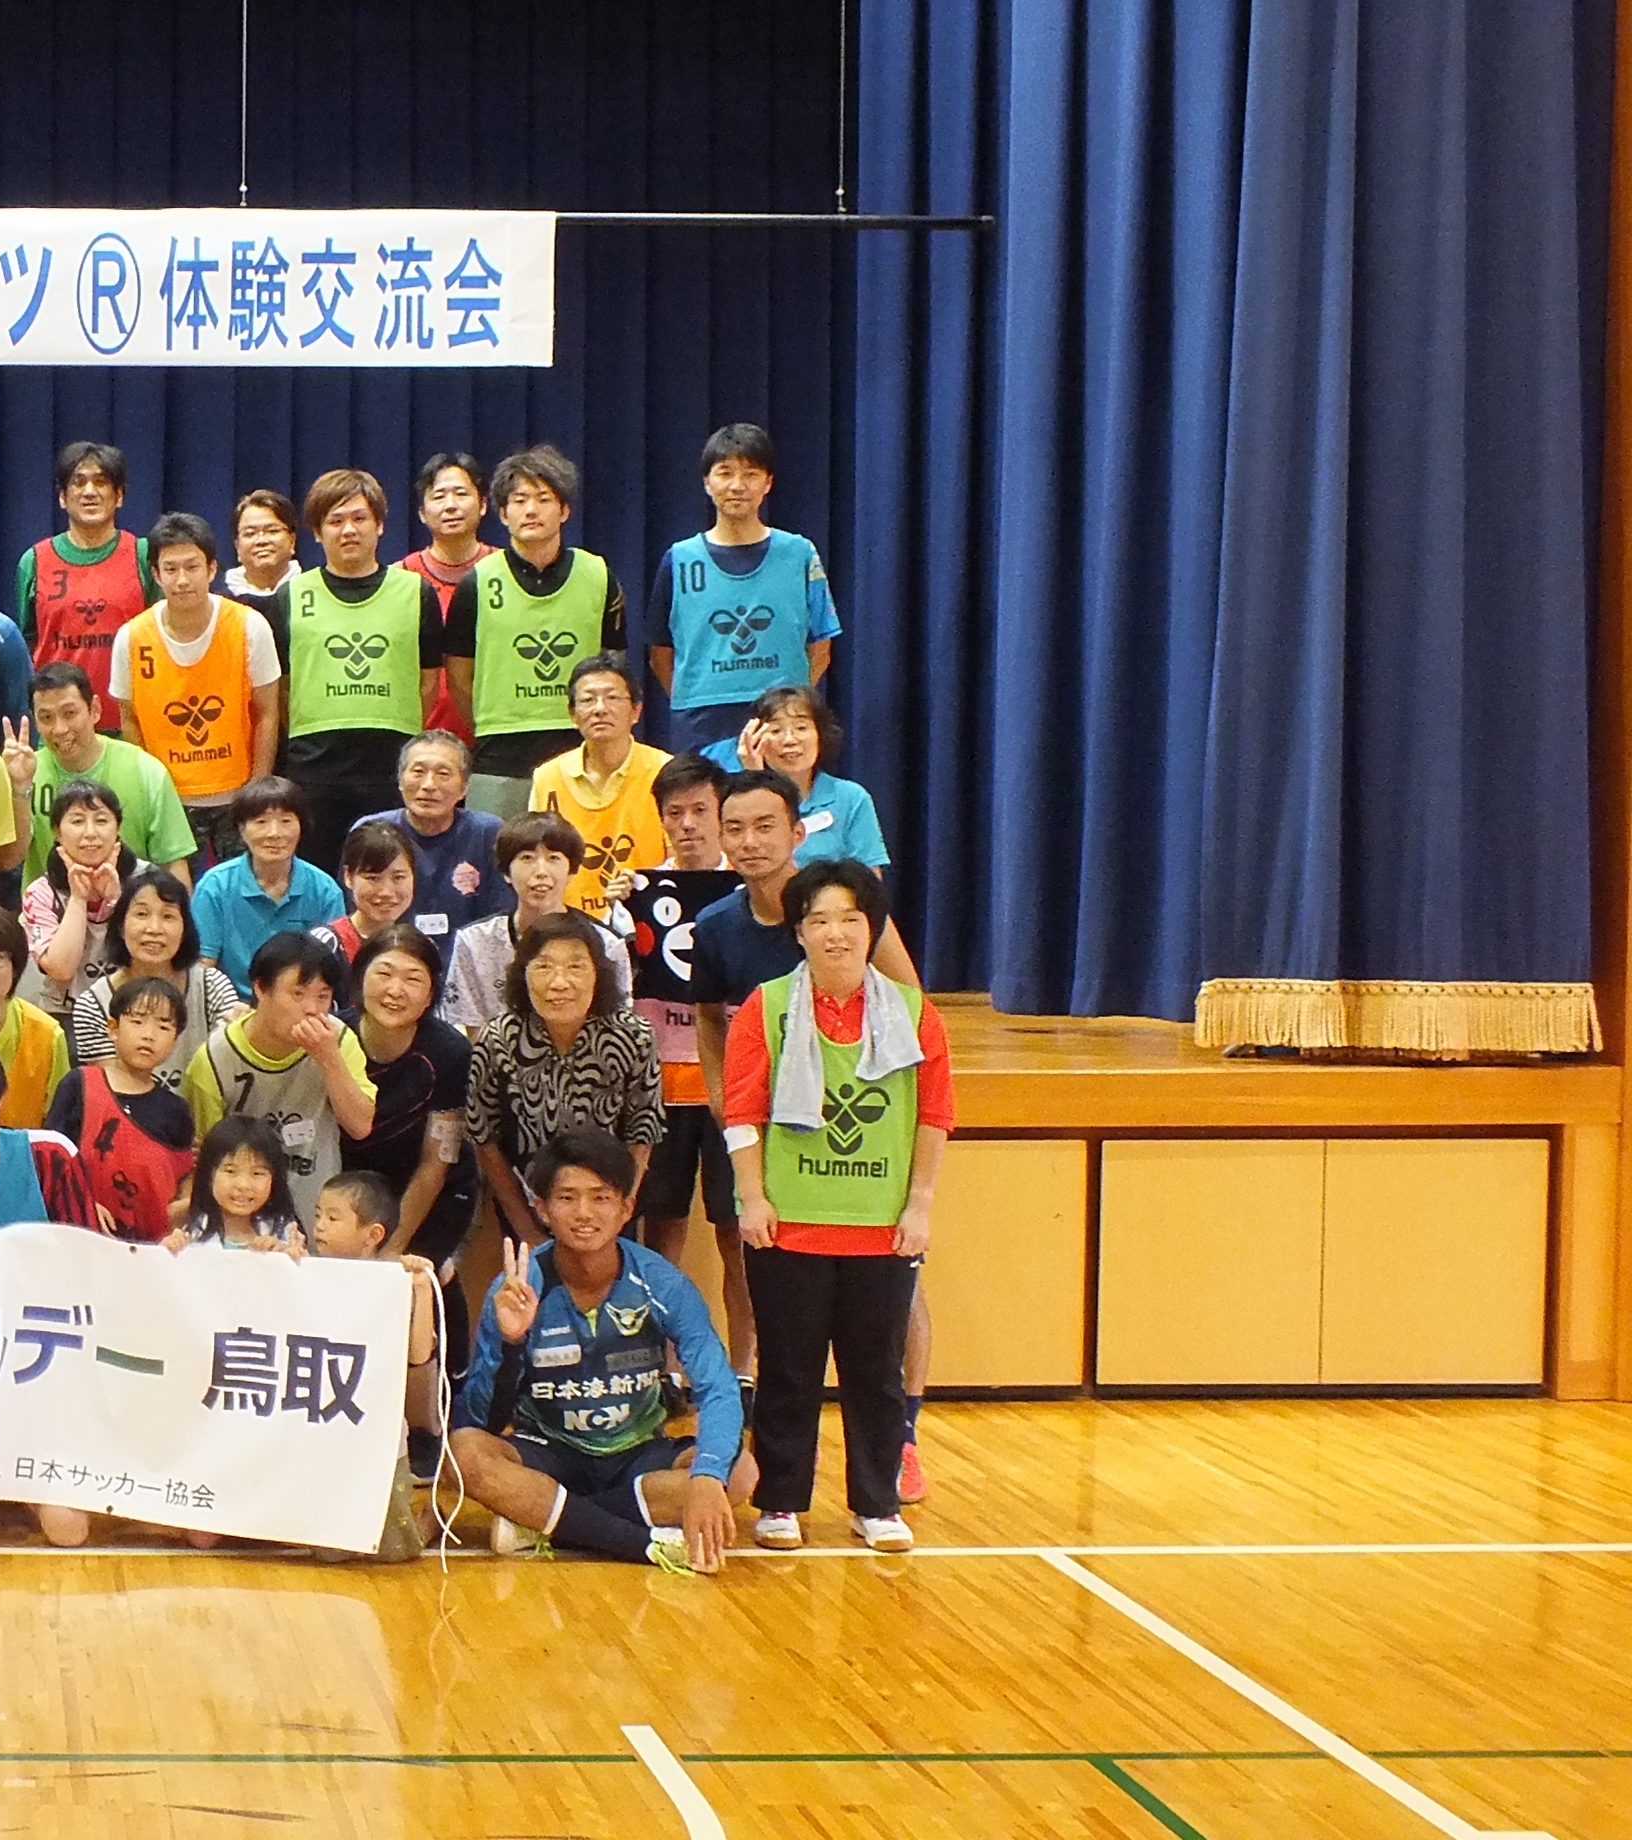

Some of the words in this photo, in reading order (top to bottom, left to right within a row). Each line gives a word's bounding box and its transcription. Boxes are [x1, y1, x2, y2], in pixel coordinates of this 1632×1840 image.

[160, 235, 503, 351] 体験交流会
[48, 569, 69, 601] 3
[679, 559, 706, 594] 10
[301, 589, 315, 618] 2
[488, 577, 504, 610] 3
[139, 645, 155, 679] 5
[711, 652, 780, 674] hummel
[325, 682, 390, 698] hummel
[168, 742, 232, 764] hummel
[234, 1071, 255, 1113] 7
[797, 1153, 889, 1179] hummel
[201, 1325, 367, 1426] 鳥取
[14, 1456, 216, 1510] 日本サッカー協会
